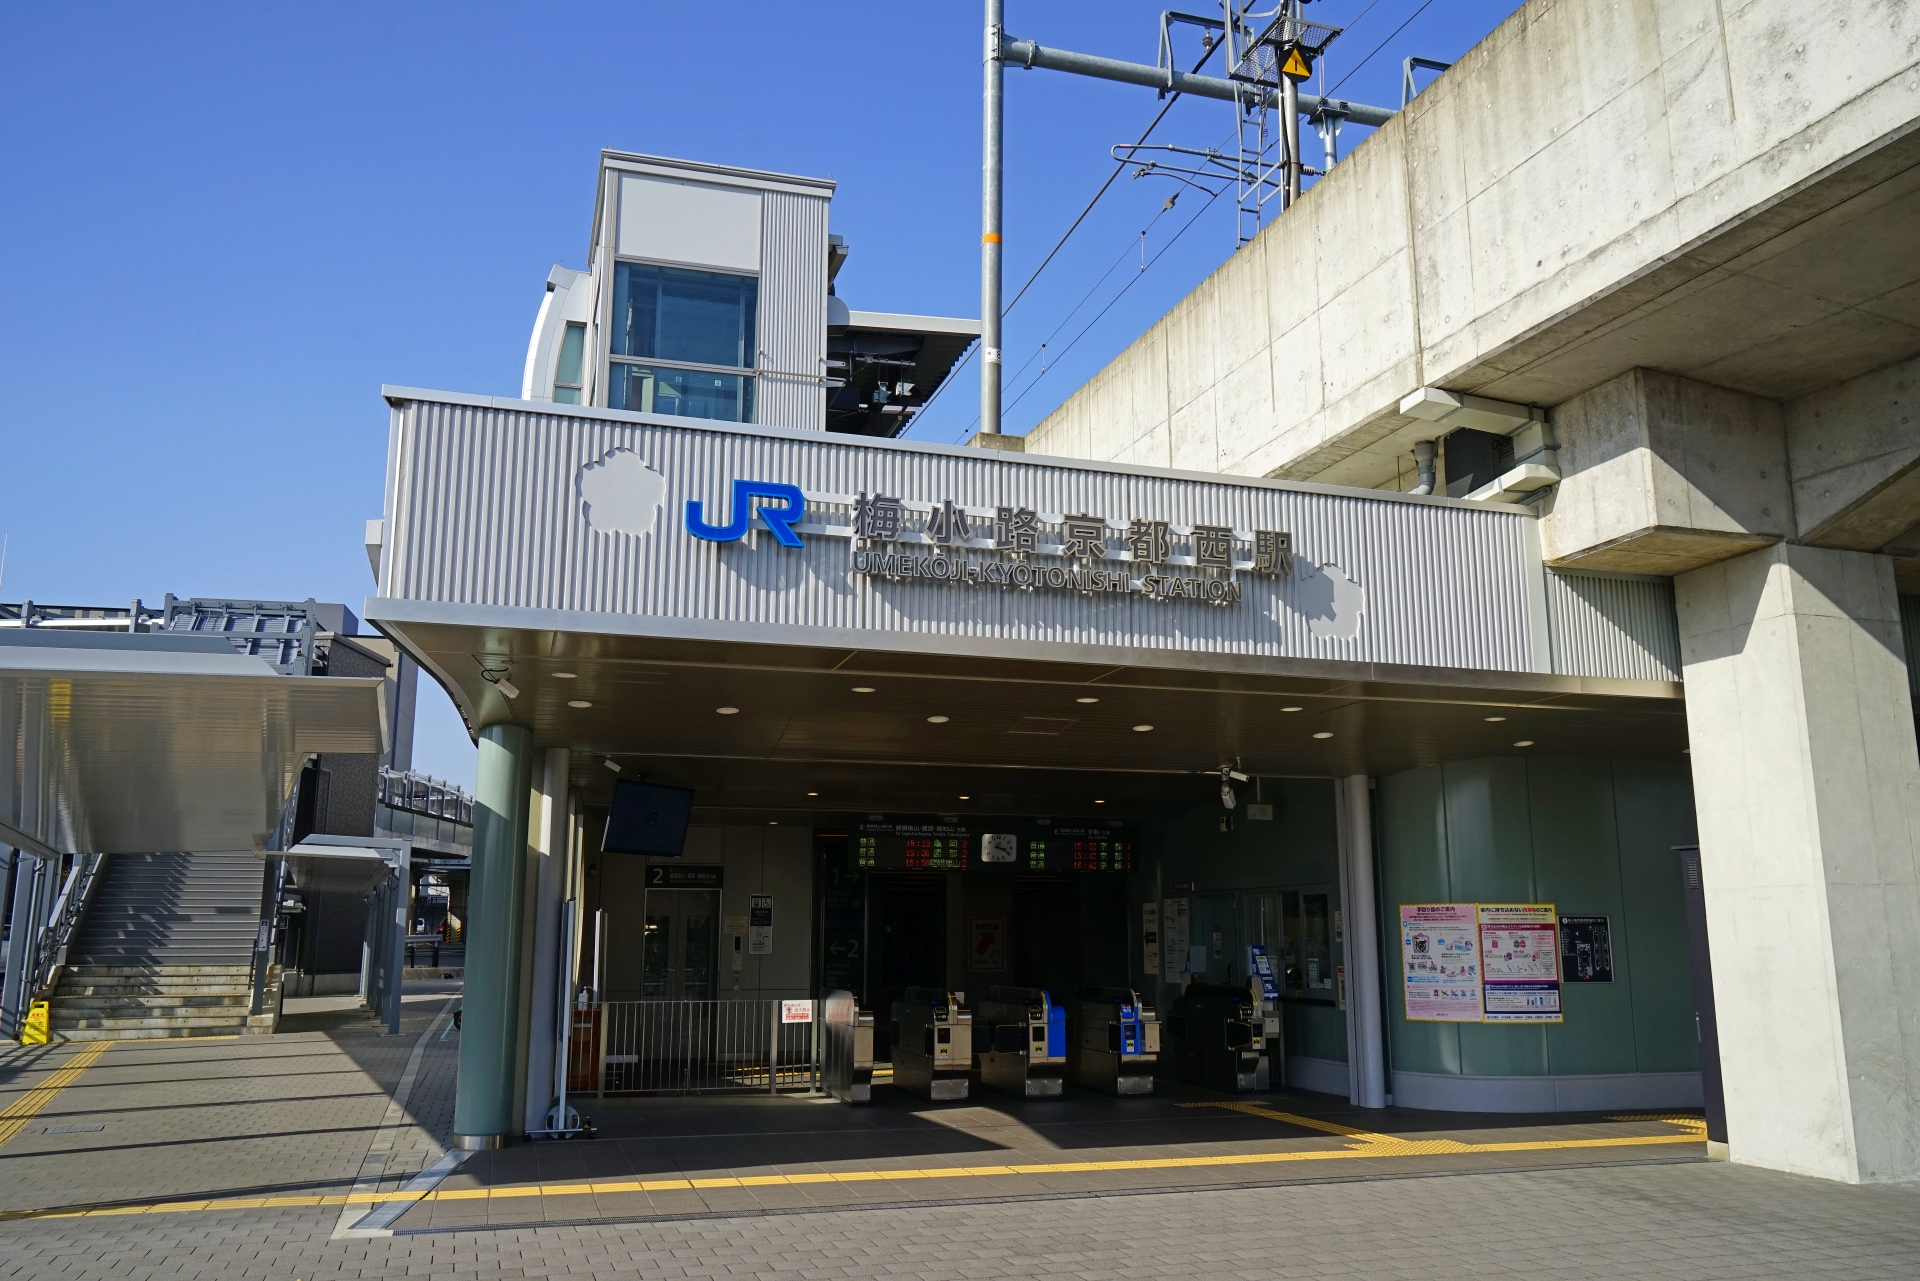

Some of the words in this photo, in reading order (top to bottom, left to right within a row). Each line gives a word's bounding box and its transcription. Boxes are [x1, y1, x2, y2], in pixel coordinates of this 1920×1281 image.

[685, 479, 805, 548] JR
[852, 490, 1294, 576] 梅小路京都西駅
[852, 549, 1131, 593] UMEKŌJI-KYŌTONISHI
[1142, 573, 1243, 603] STATION
[859, 838, 875, 847] 普通
[906, 839, 931, 848] 15:19
[962, 840, 968, 848] 2
[1029, 841, 1045, 850] 普通
[1073, 842, 1097, 851] 15:22
[859, 848, 875, 857] 普通
[906, 849, 930, 857] 15:36
[961, 850, 967, 858] 2
[1029, 851, 1045, 860] 普通
[1073, 852, 1097, 860] 15:42
[858, 858, 875, 867] 普通
[961, 860, 967, 868] 2
[1029, 860, 1045, 869] 普通
[1073, 861, 1097, 870] 16:02
[652, 868, 664, 884] 2
[831, 867, 839, 885] 1
[847, 939, 859, 958] 2
